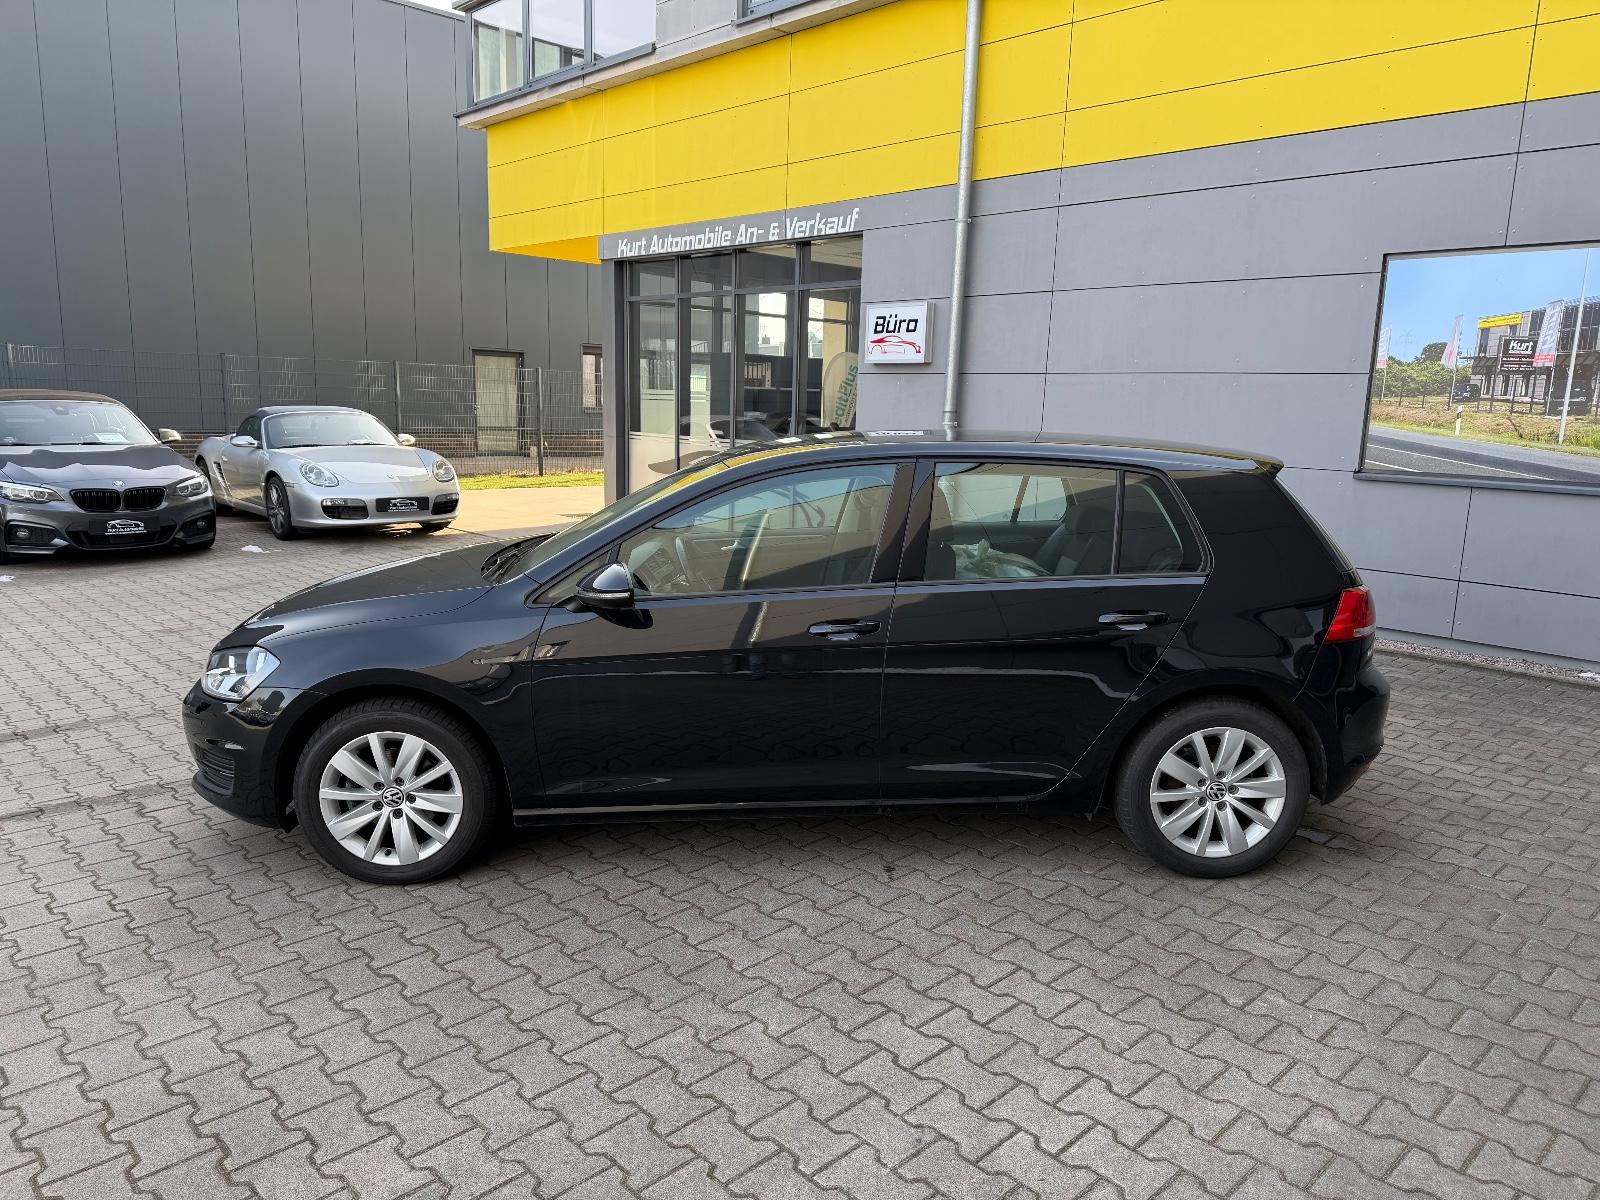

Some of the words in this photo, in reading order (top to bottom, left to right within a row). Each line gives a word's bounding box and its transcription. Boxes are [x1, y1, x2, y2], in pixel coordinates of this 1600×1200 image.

[617, 237, 647, 258] Kurt
[649, 225, 732, 254] Automobile
[735, 223, 764, 245] An-
[768, 222, 780, 241] &
[786, 207, 860, 240] Verkauf
[873, 313, 919, 335] Büro
[1508, 340, 1534, 352] Kurt
